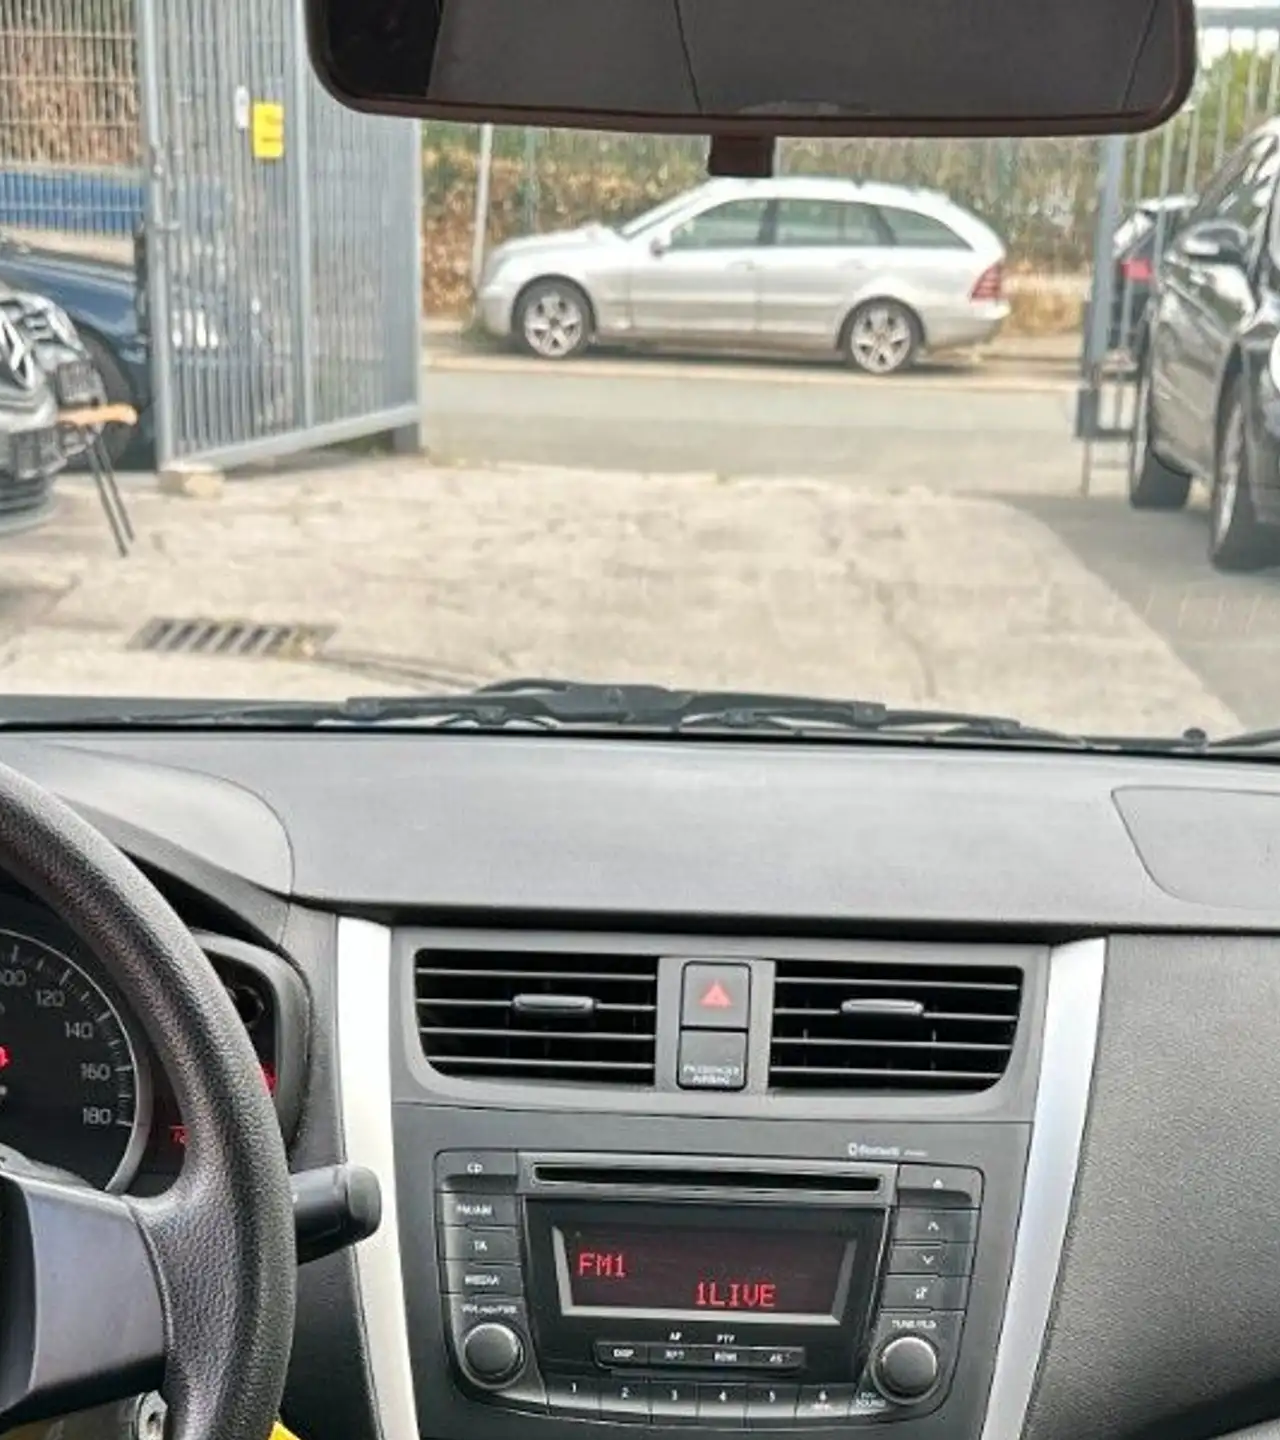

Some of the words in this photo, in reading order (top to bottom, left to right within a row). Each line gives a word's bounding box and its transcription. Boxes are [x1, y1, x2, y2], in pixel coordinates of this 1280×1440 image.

[36, 990, 65, 1007] 120
[65, 1021, 94, 1039] 140
[80, 1063, 111, 1081] 160
[83, 1107, 112, 1125] 180
[578, 1252, 627, 1278] FM1
[696, 1281, 776, 1308] 1LIVE
